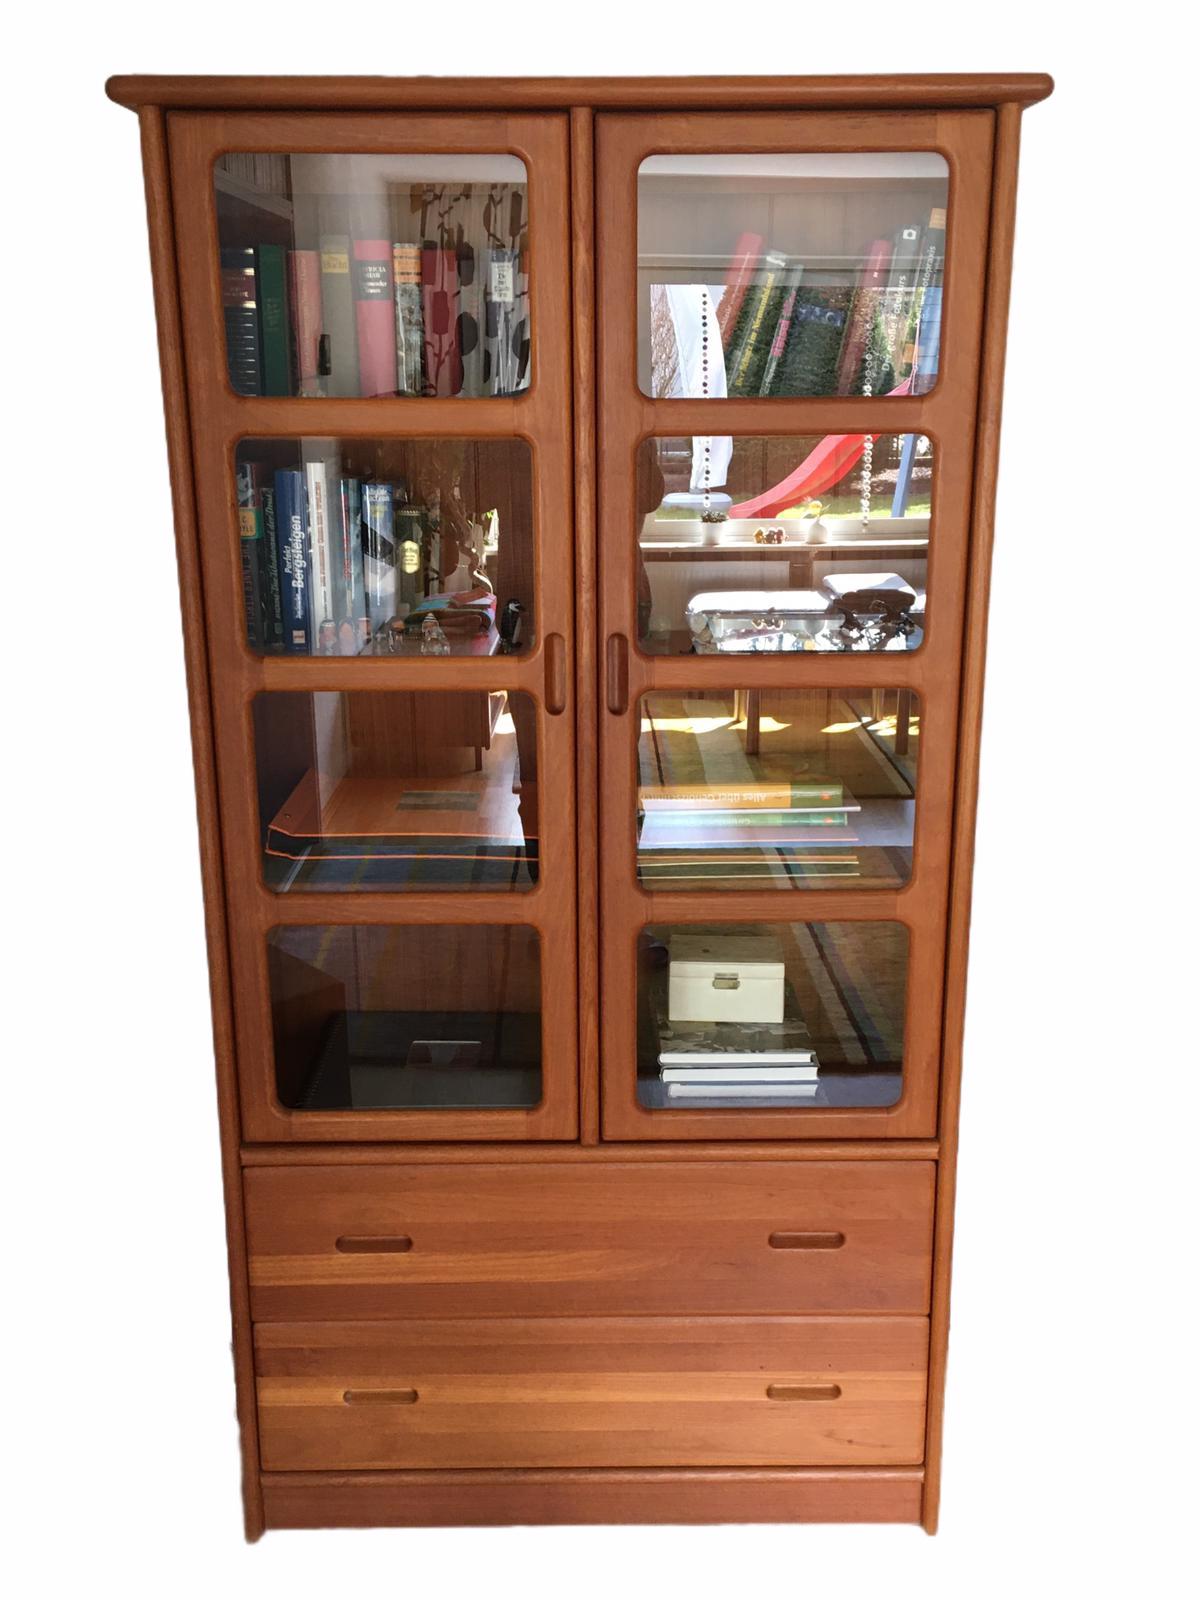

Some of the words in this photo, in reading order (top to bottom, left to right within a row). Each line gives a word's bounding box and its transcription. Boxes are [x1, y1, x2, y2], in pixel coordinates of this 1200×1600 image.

[922, 246, 936, 293] otopraxis
[284, 545, 292, 574] Perfekt
[291, 515, 307, 588] Bergsteigen
[742, 792, 768, 803] Alles
